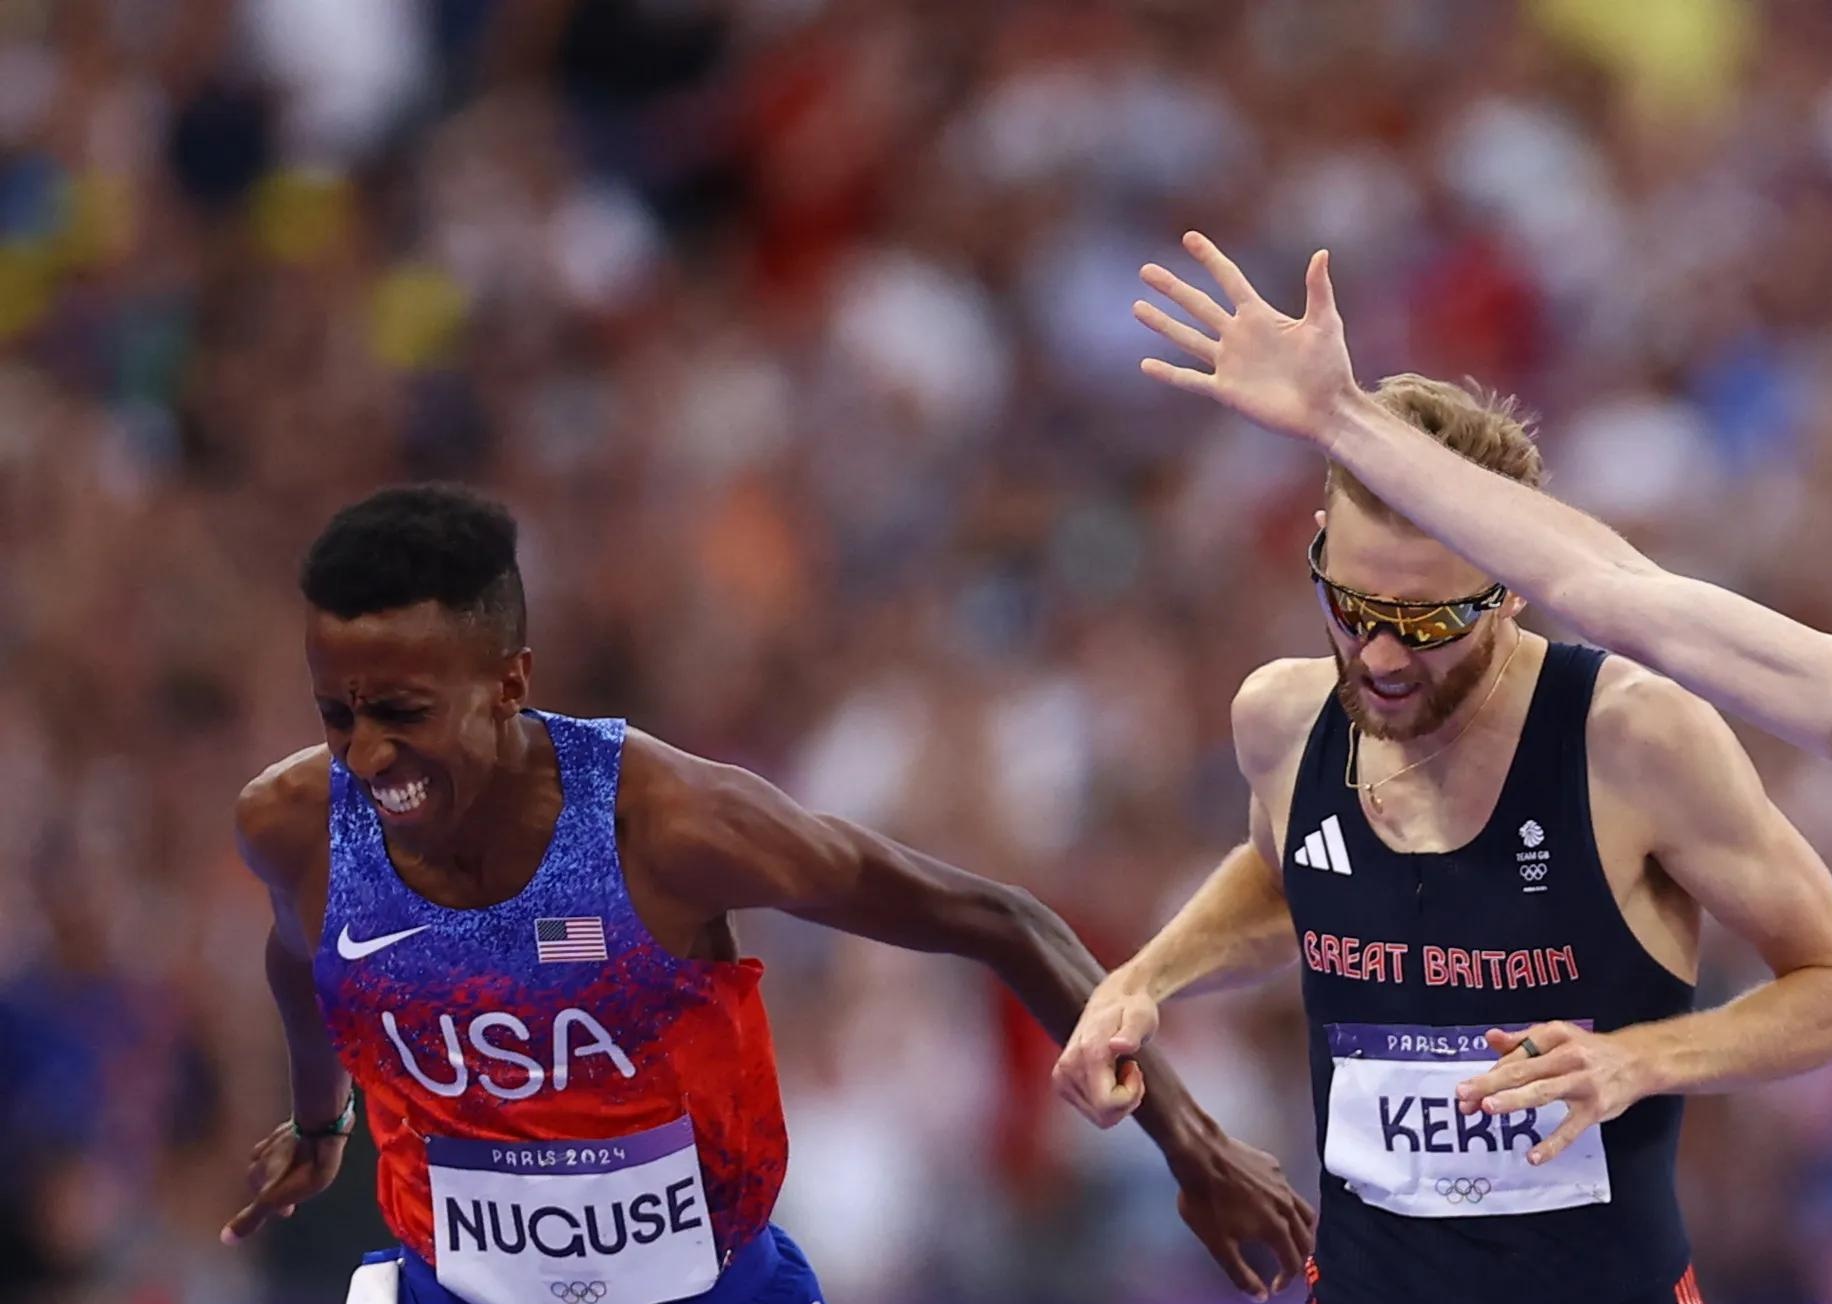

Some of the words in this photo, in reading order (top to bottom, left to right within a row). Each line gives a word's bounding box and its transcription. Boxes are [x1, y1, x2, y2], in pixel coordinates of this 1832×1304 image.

[1304, 930, 1408, 983] GREAT
[1423, 945, 1578, 990] BRITAIN
[381, 1008, 636, 1099] USA
[1387, 1035, 1449, 1051] PARIS
[1458, 1035, 1489, 1051] 20
[1379, 1096, 1543, 1153] KERR
[492, 1148, 556, 1167] PARIS
[564, 1147, 626, 1166] 2024
[446, 1176, 702, 1258] NUGUSE
